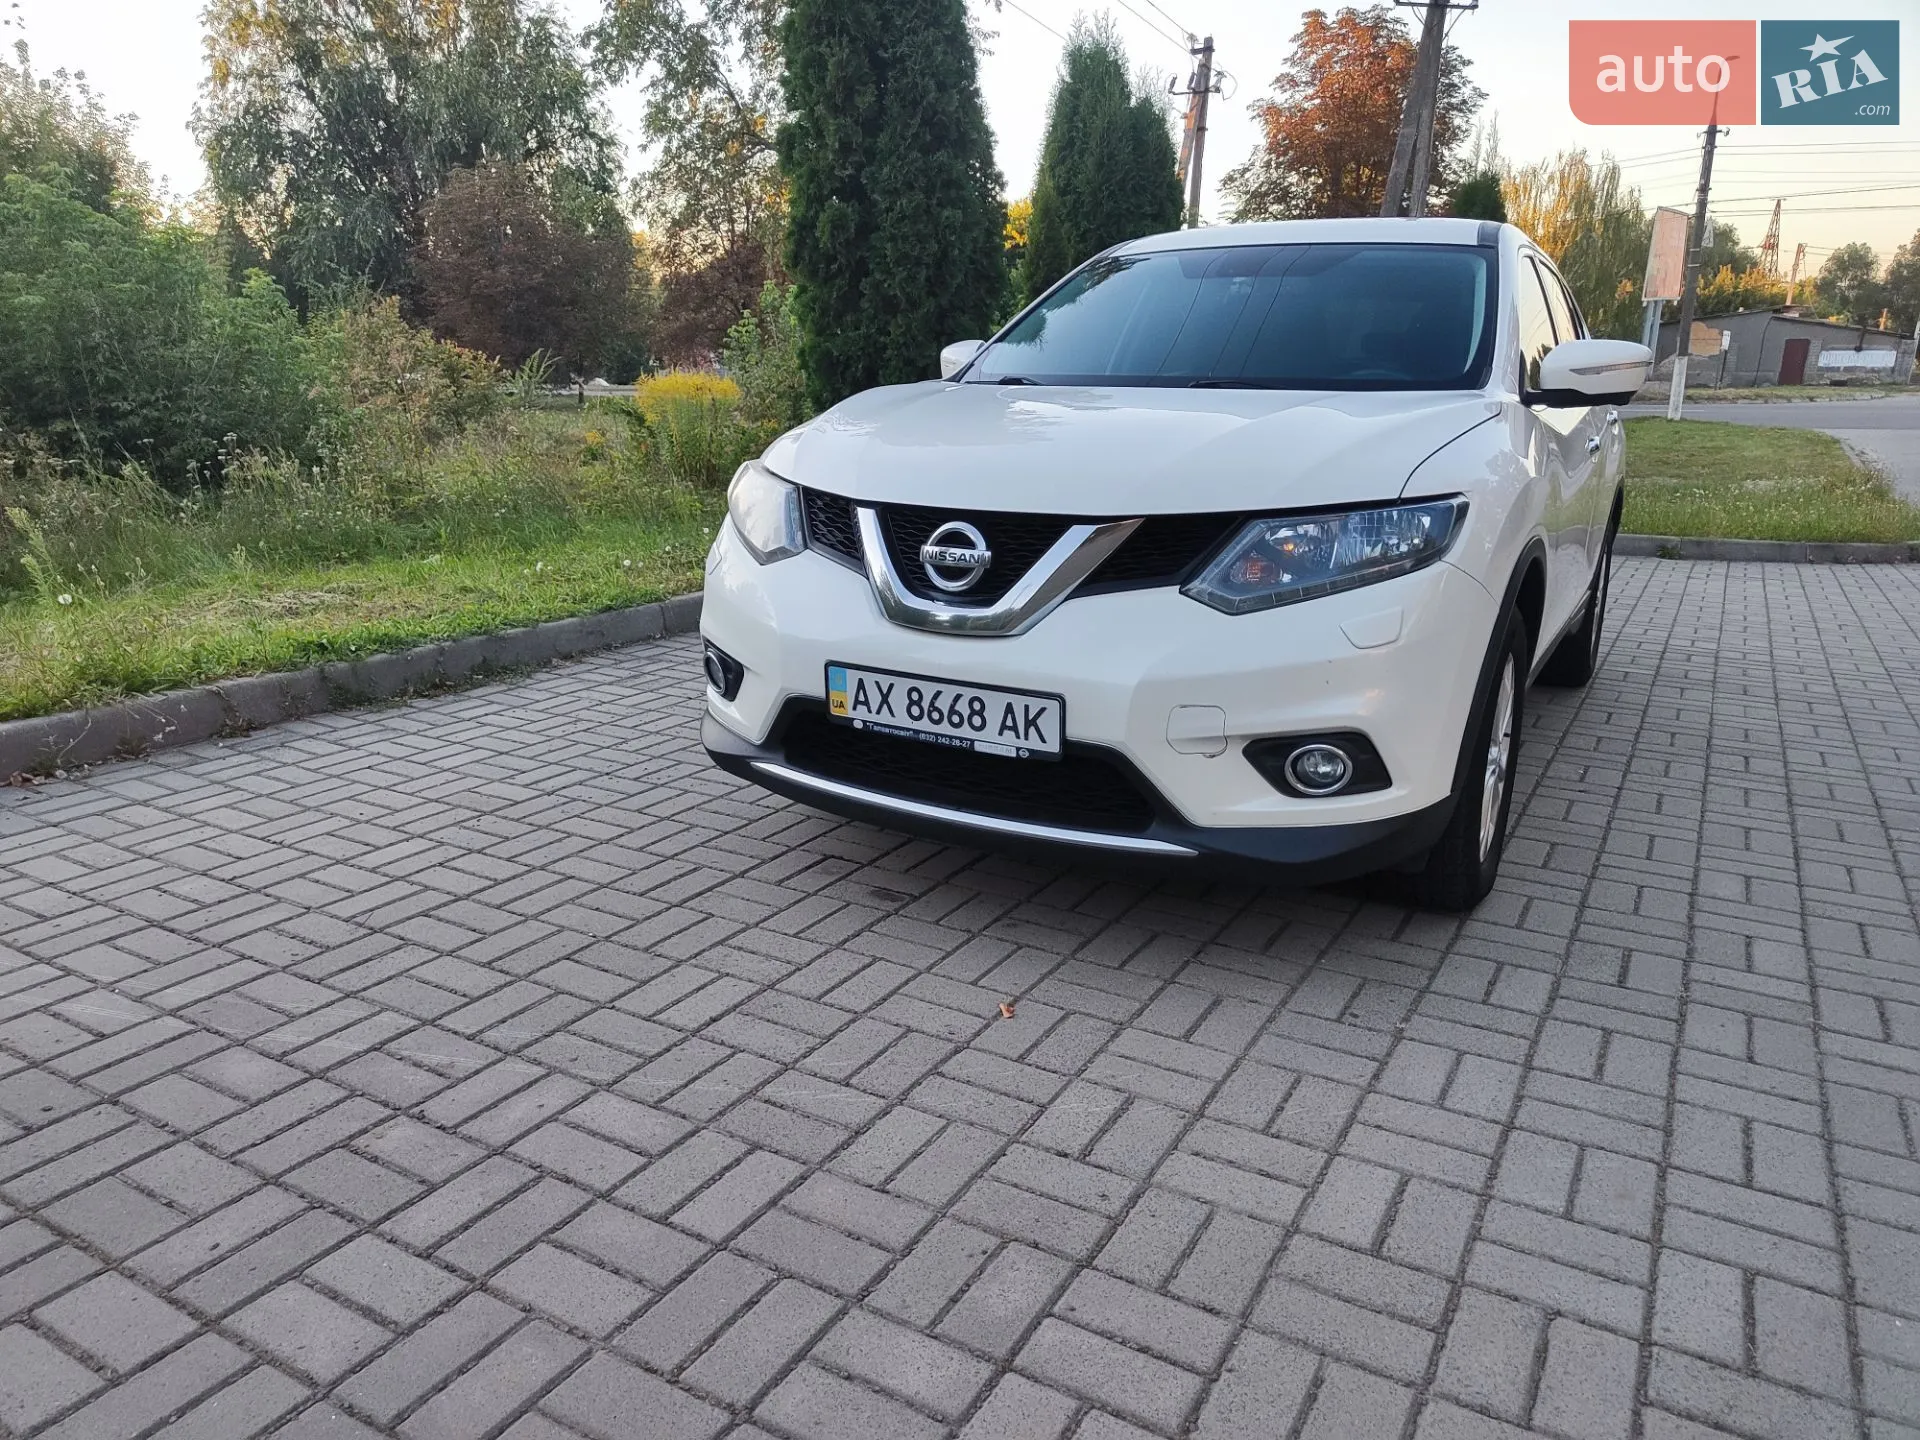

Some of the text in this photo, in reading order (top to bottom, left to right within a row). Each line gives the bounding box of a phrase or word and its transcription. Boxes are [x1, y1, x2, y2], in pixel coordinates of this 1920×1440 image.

[924, 549, 980, 564] NISSAN
[831, 699, 846, 711] UA
[852, 677, 1048, 744] AX 8668 AK
